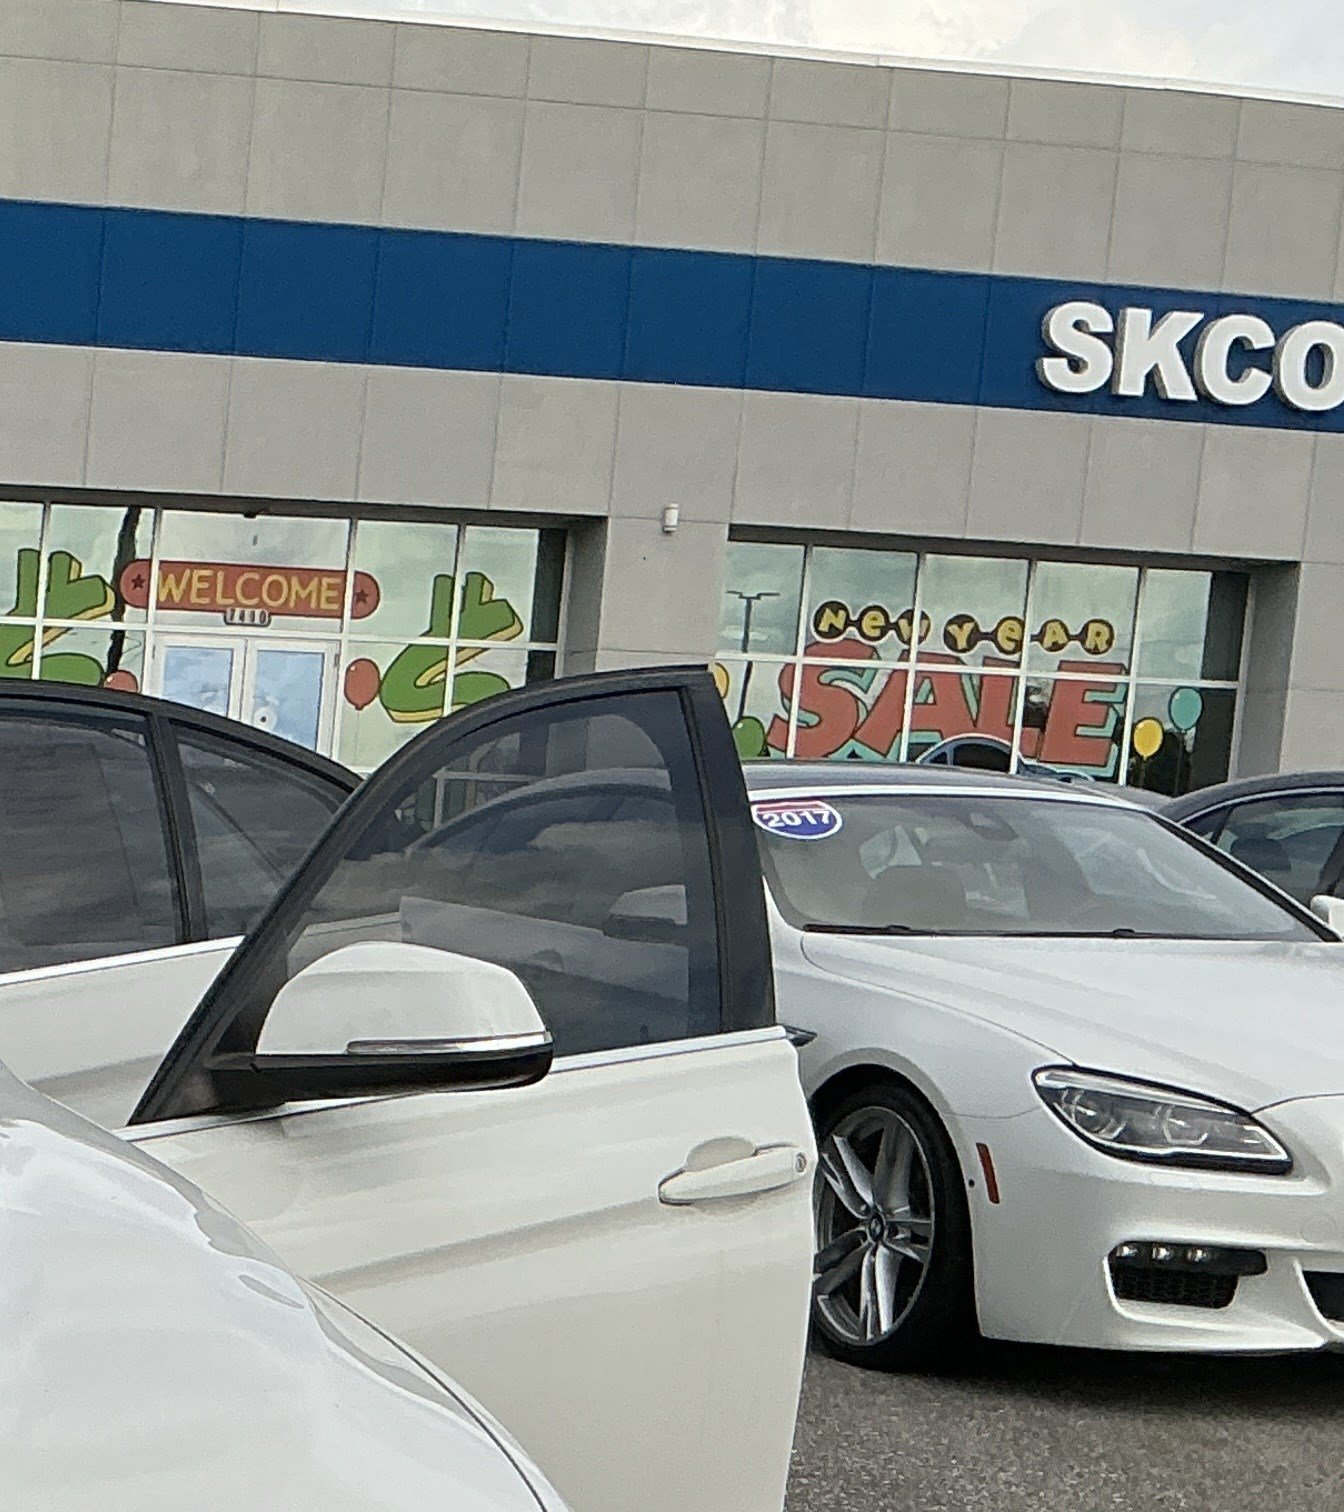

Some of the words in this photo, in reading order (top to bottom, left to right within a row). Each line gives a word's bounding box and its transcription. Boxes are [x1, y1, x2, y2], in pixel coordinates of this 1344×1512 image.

[1036, 301, 1344, 412] SKCO
[158, 567, 343, 612] WELCOME
[766, 638, 1128, 777] SALE
[762, 809, 831, 829] 2017
